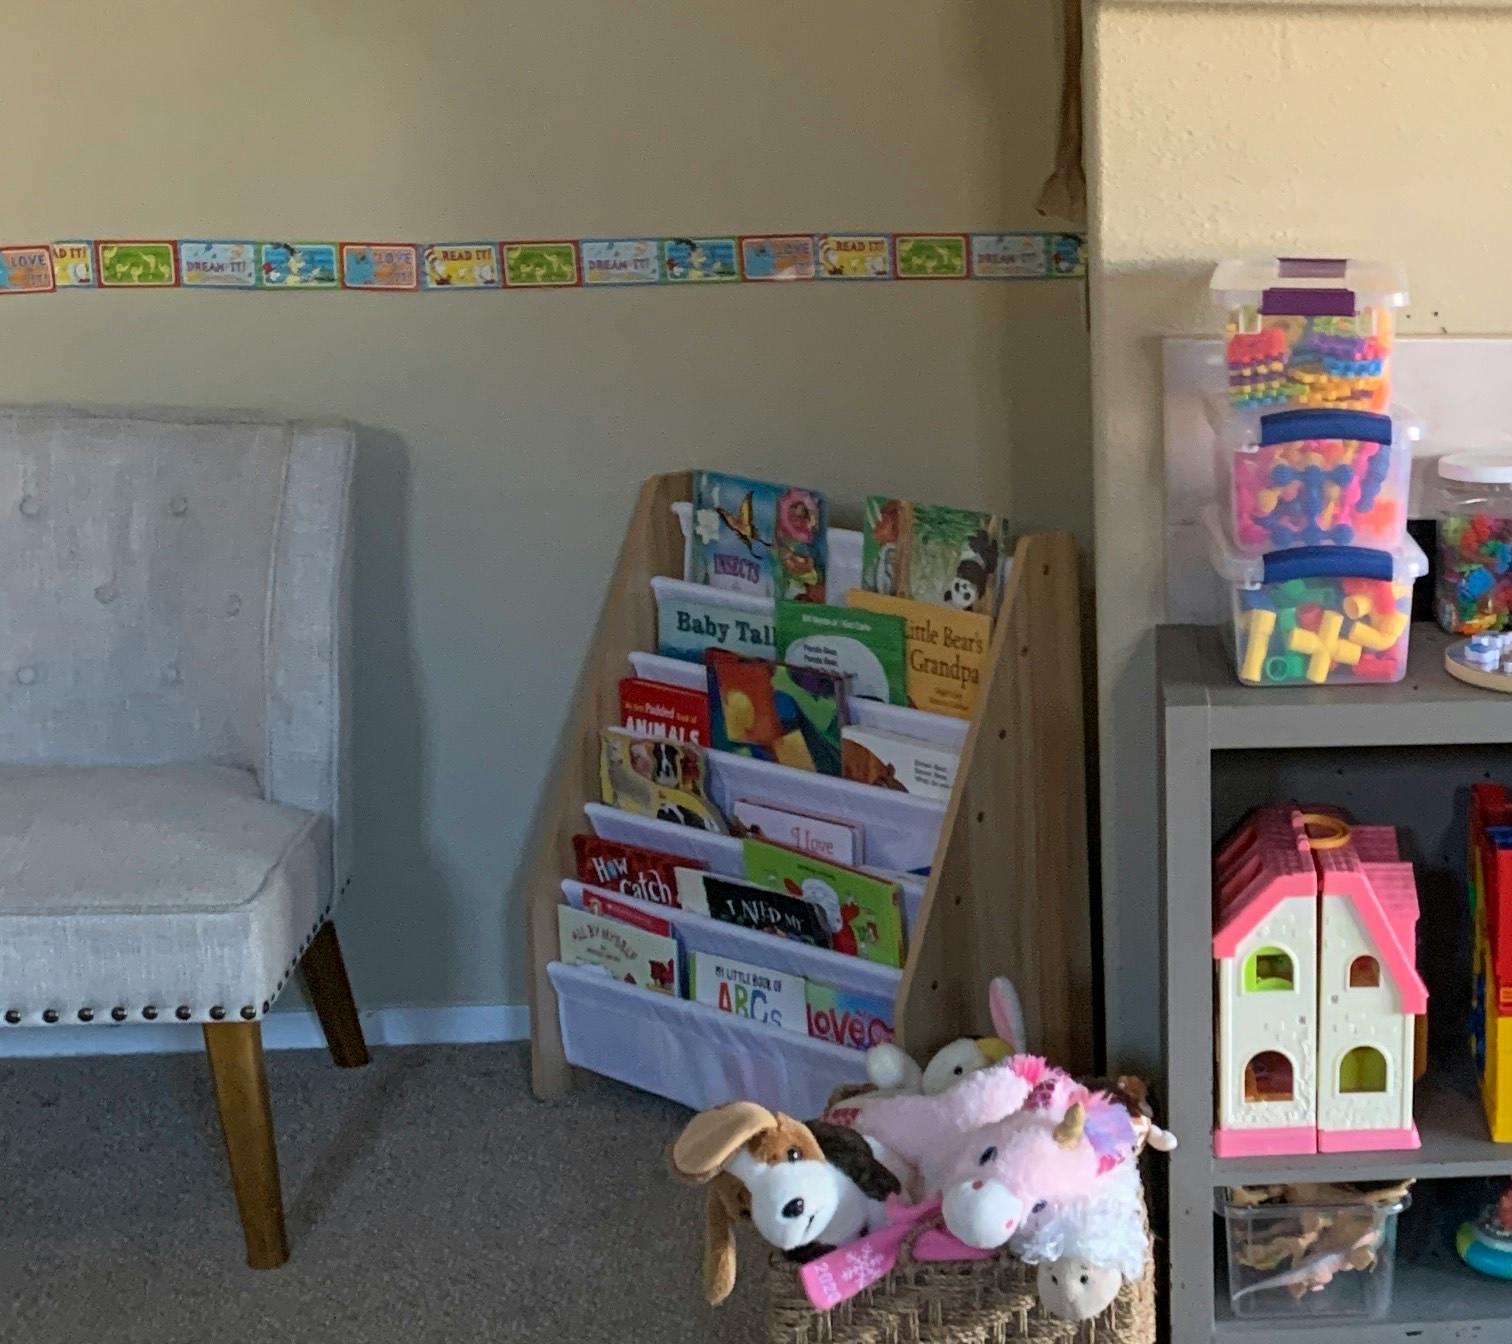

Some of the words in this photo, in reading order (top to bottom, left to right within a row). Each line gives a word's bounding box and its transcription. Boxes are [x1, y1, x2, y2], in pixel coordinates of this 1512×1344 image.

[441, 249, 472, 261] READ
[836, 241, 865, 252] READ
[187, 260, 224, 273] DREAM
[713, 553, 761, 585] INSECTS
[677, 610, 730, 644] Baby
[910, 649, 980, 690] Grandpa
[805, 829, 834, 855] love
[592, 855, 629, 883] How
[727, 969, 750, 985] LITTLE
[752, 973, 772, 992] BOOK
